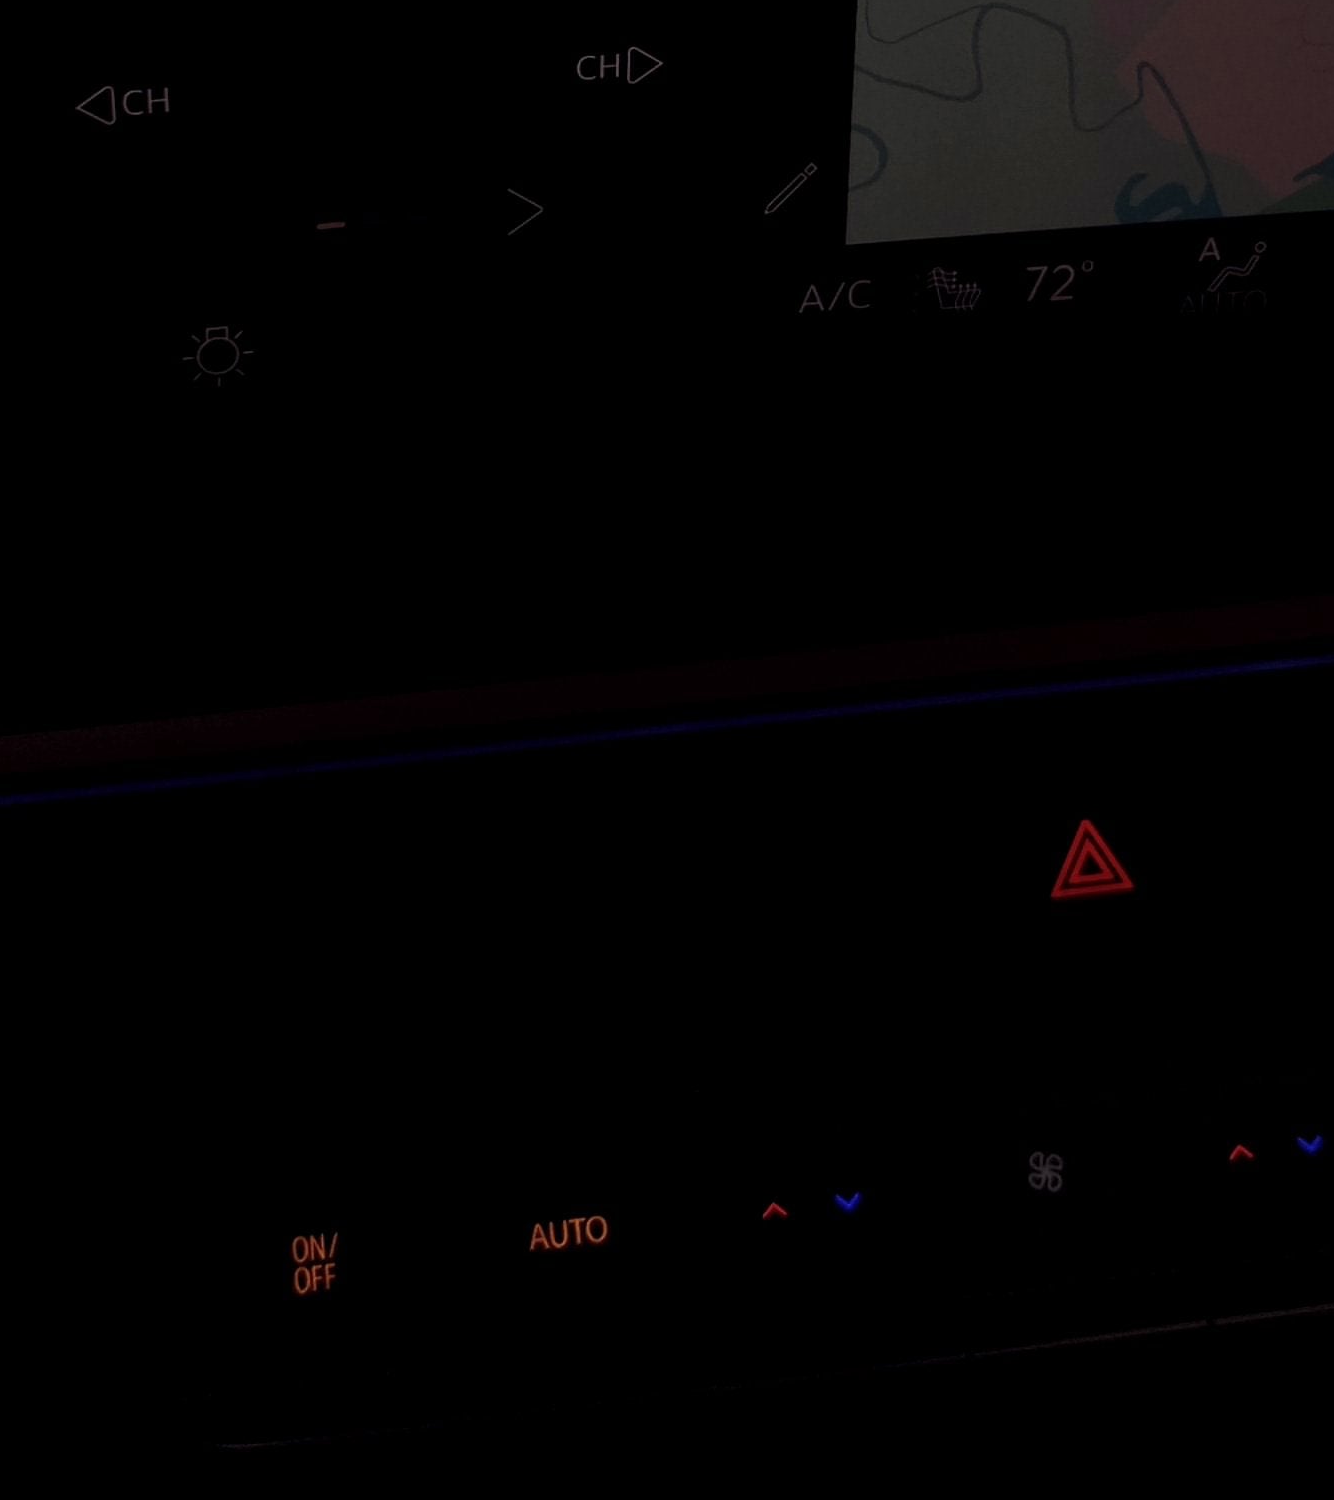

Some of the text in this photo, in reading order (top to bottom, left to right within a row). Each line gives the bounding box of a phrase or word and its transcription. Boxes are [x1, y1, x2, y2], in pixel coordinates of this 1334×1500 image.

[577, 53, 620, 81] CH
[122, 87, 170, 116] CH
[1198, 235, 1222, 263] A
[798, 279, 872, 314] A/C
[1026, 260, 1094, 301] 72°
[291, 1232, 338, 1263] ON/
[529, 1215, 609, 1251] AUTO
[293, 1262, 336, 1295] OFF
